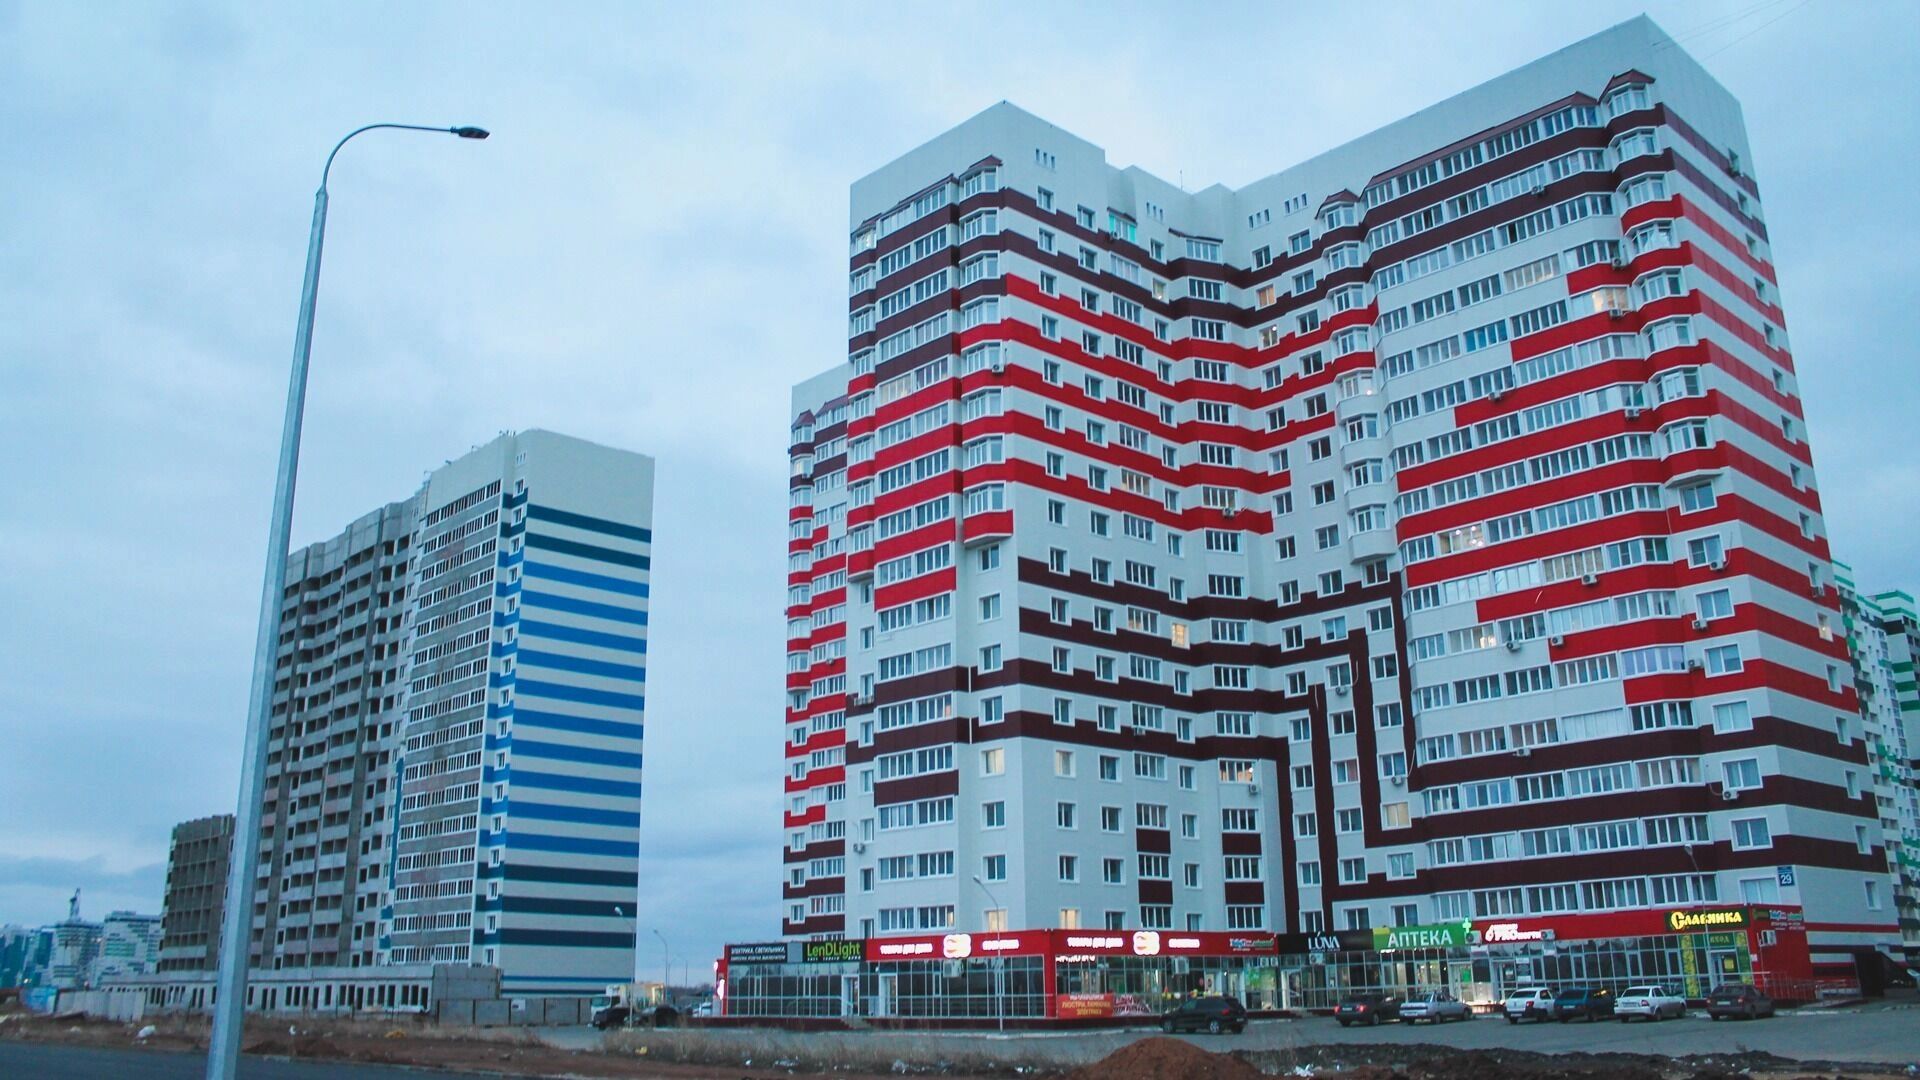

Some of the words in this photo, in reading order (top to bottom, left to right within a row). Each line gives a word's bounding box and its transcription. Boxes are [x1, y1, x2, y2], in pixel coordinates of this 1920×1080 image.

[1780, 873, 1792, 885] 29
[1387, 929, 1453, 948] АПТЕКА
[807, 941, 861, 960] LenDLight
